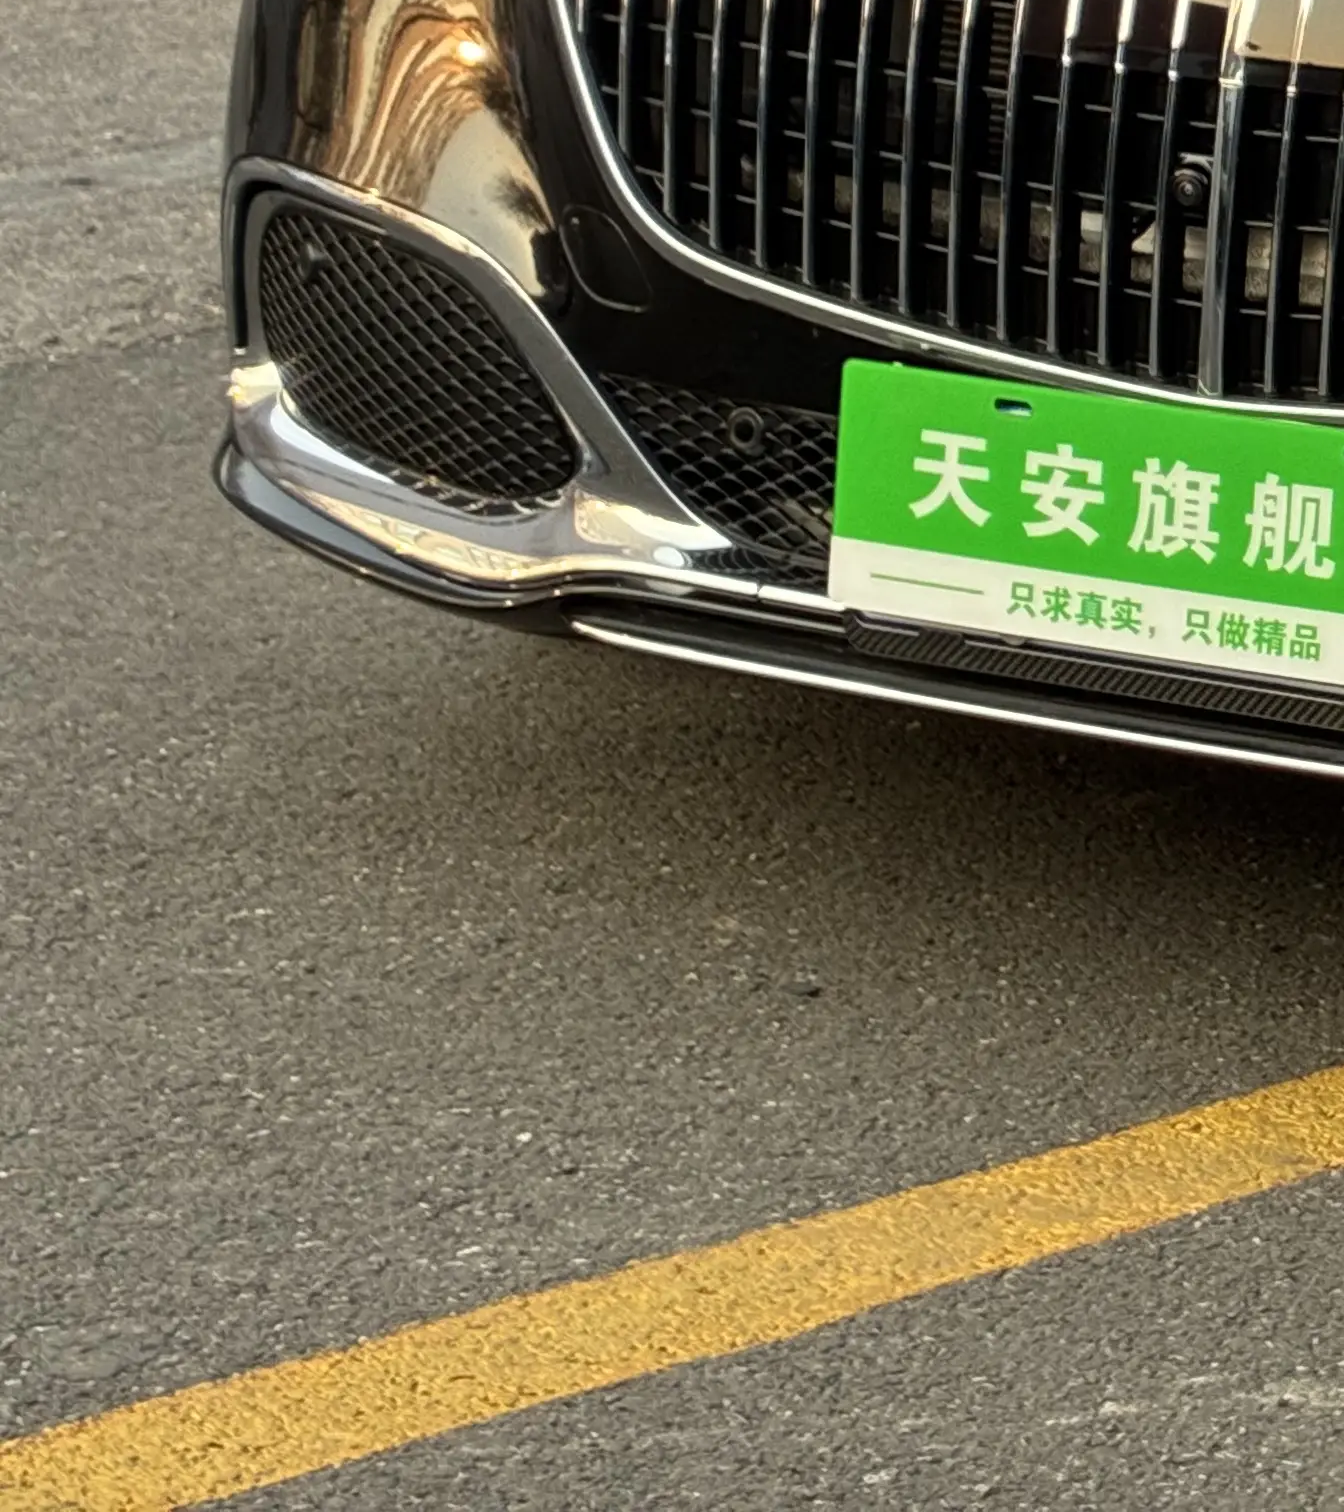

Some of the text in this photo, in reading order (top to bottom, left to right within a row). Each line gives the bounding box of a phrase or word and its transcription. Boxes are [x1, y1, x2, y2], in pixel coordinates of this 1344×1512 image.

[1005, 580, 1322, 662] 只求真实，只做精品
